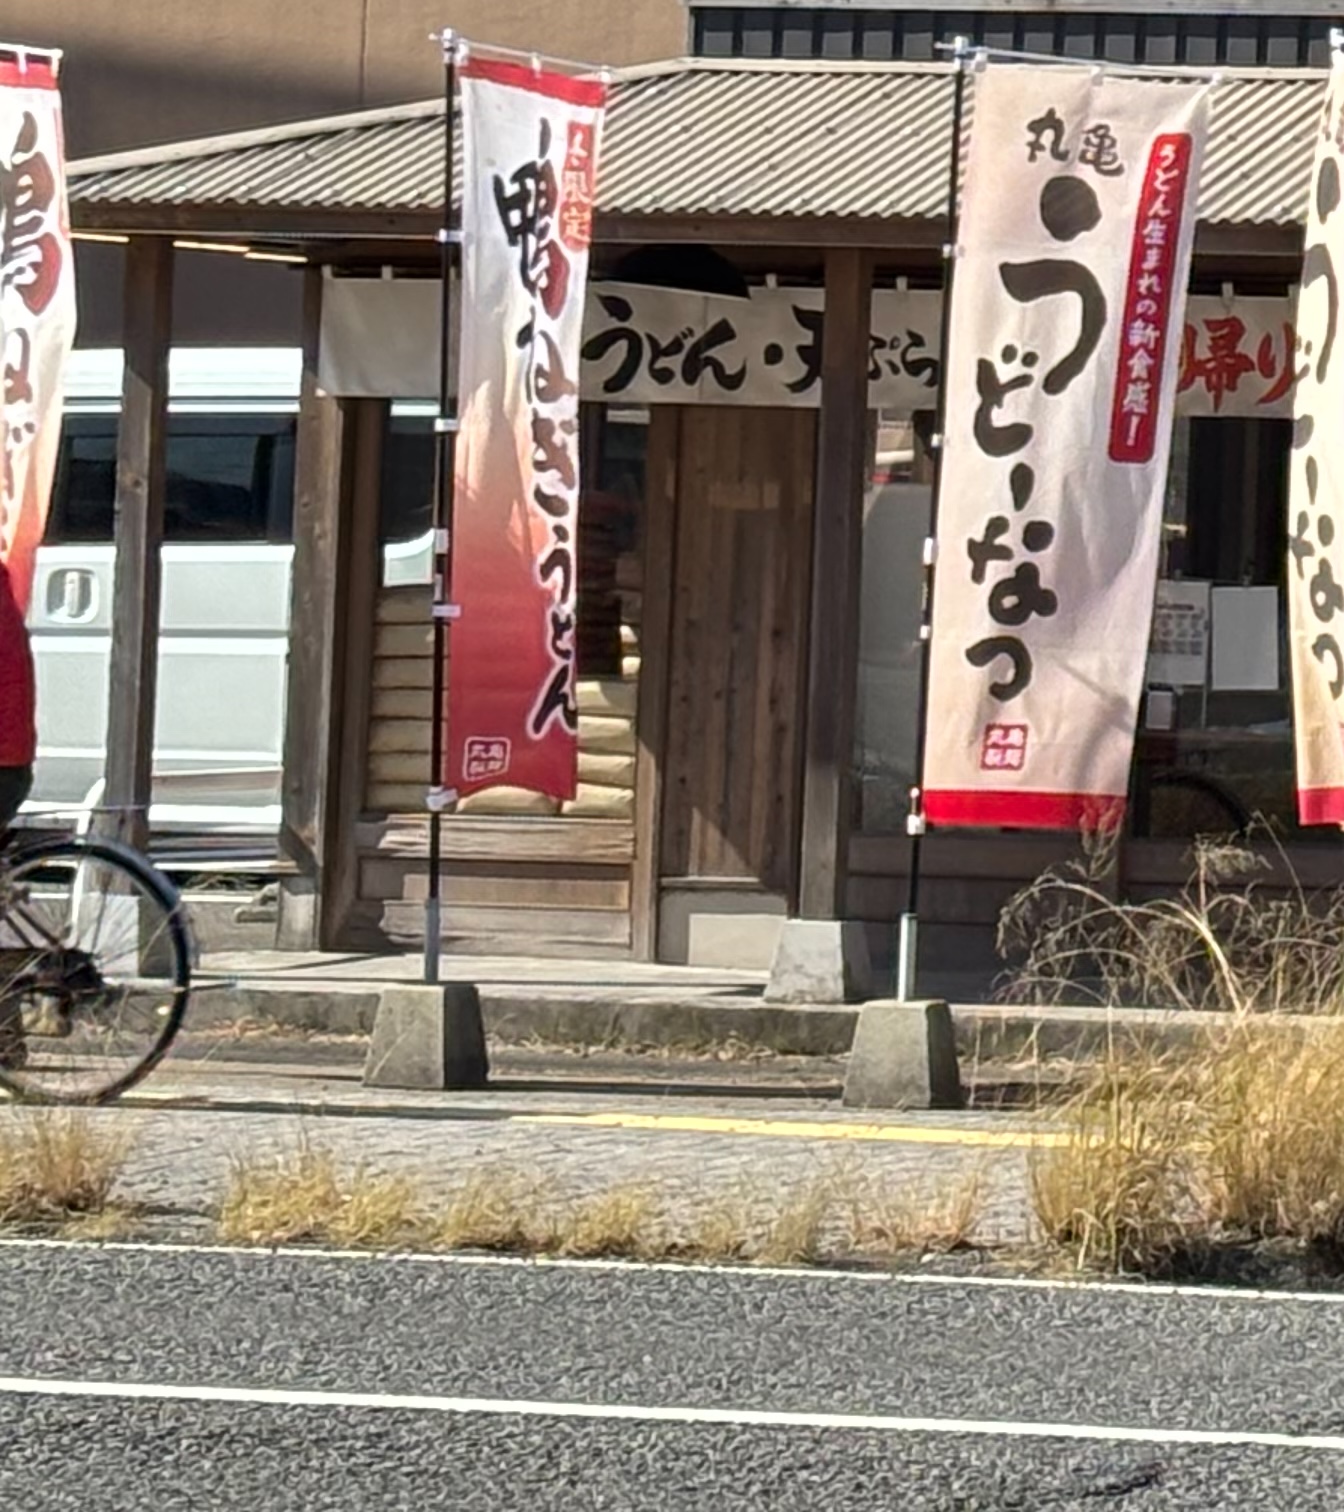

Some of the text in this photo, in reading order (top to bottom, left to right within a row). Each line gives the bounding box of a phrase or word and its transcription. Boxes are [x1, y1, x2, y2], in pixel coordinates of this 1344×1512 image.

[1025, 107, 1125, 177] 丸亀
[965, 174, 1107, 702] うどーなつ
